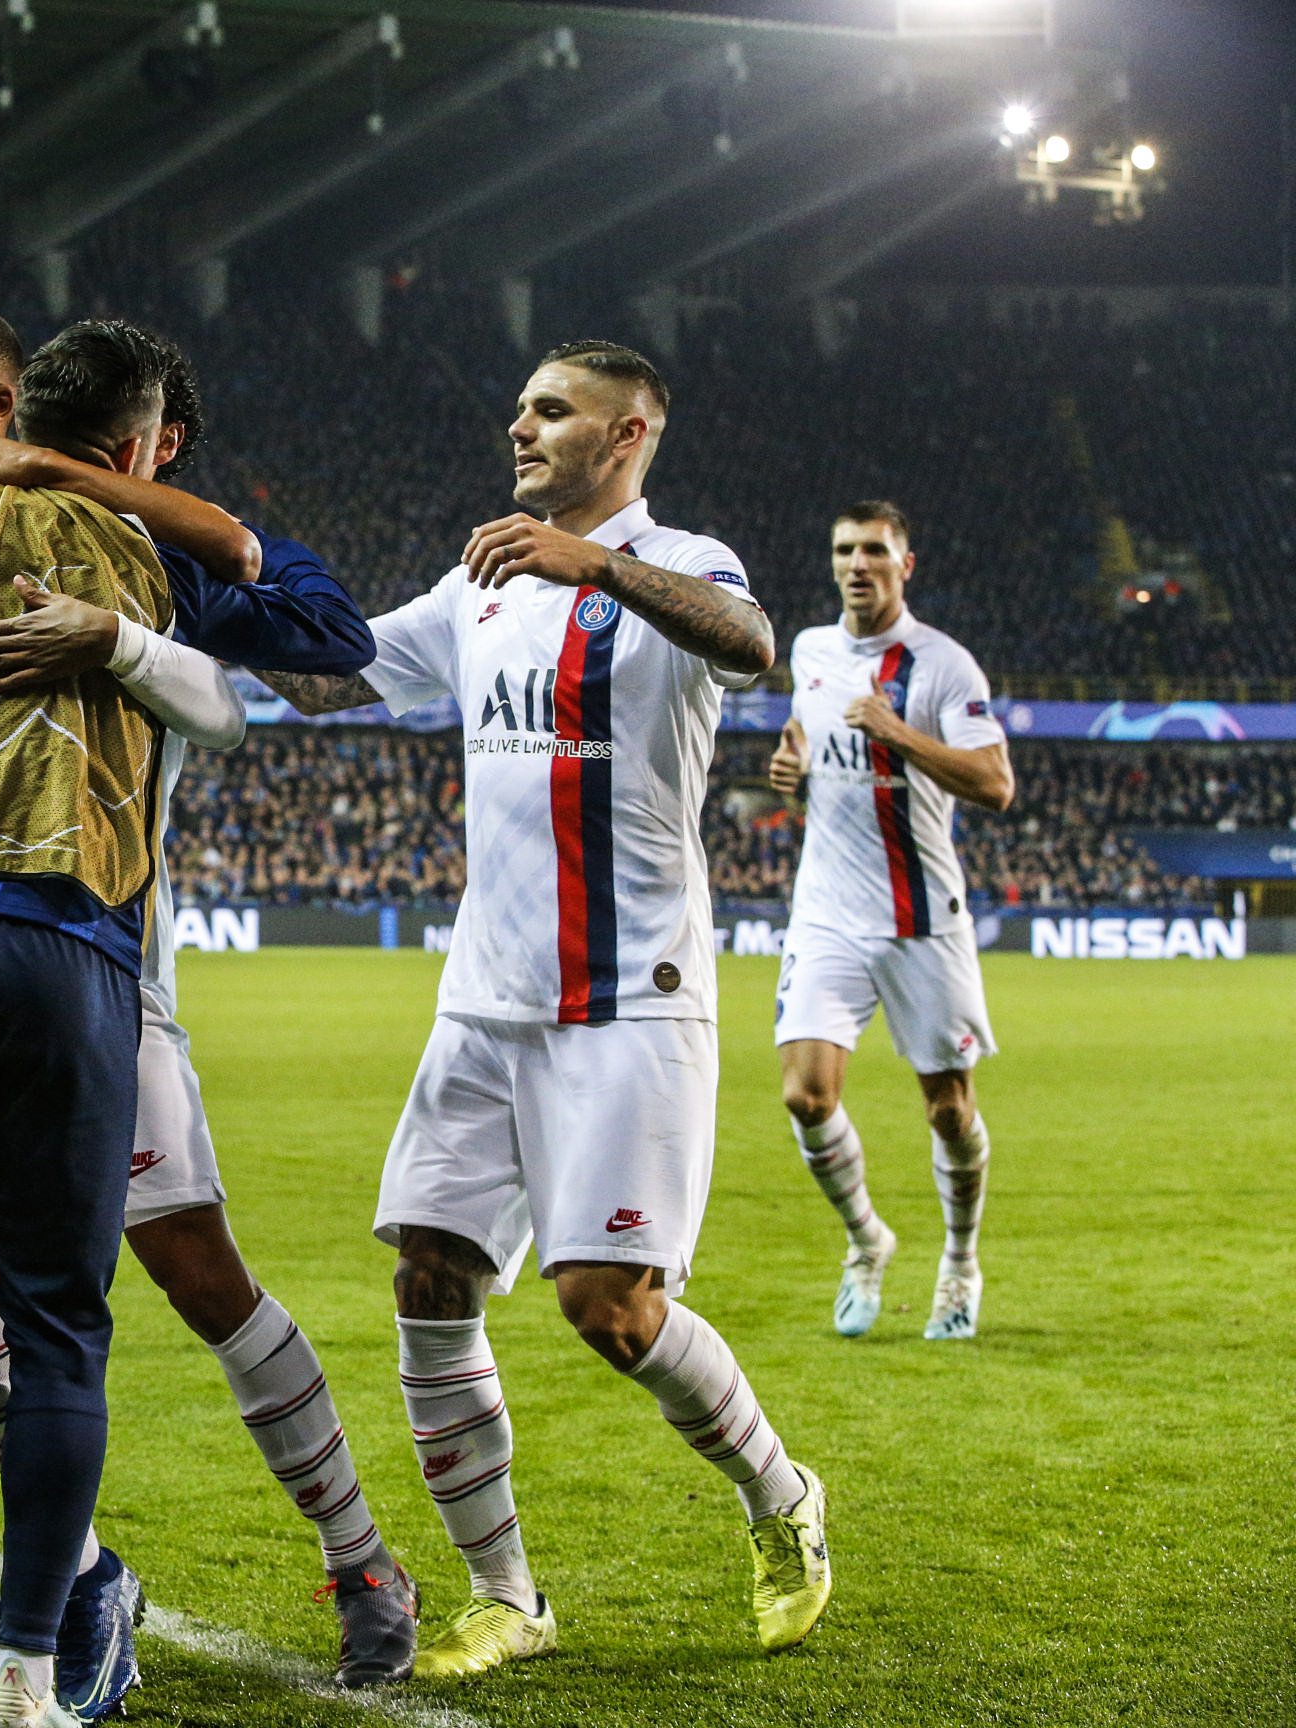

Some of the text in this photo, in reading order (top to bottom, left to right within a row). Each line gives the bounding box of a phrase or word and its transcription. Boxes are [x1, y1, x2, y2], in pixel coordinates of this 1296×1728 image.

[488, 739, 520, 754] LIVE
[524, 739, 613, 758] LIMITLESS
[173, 908, 259, 952] AN
[1031, 917, 1247, 959] NISSAN
[613, 1208, 643, 1223] NIKE
[426, 1449, 460, 1470] NIKE
